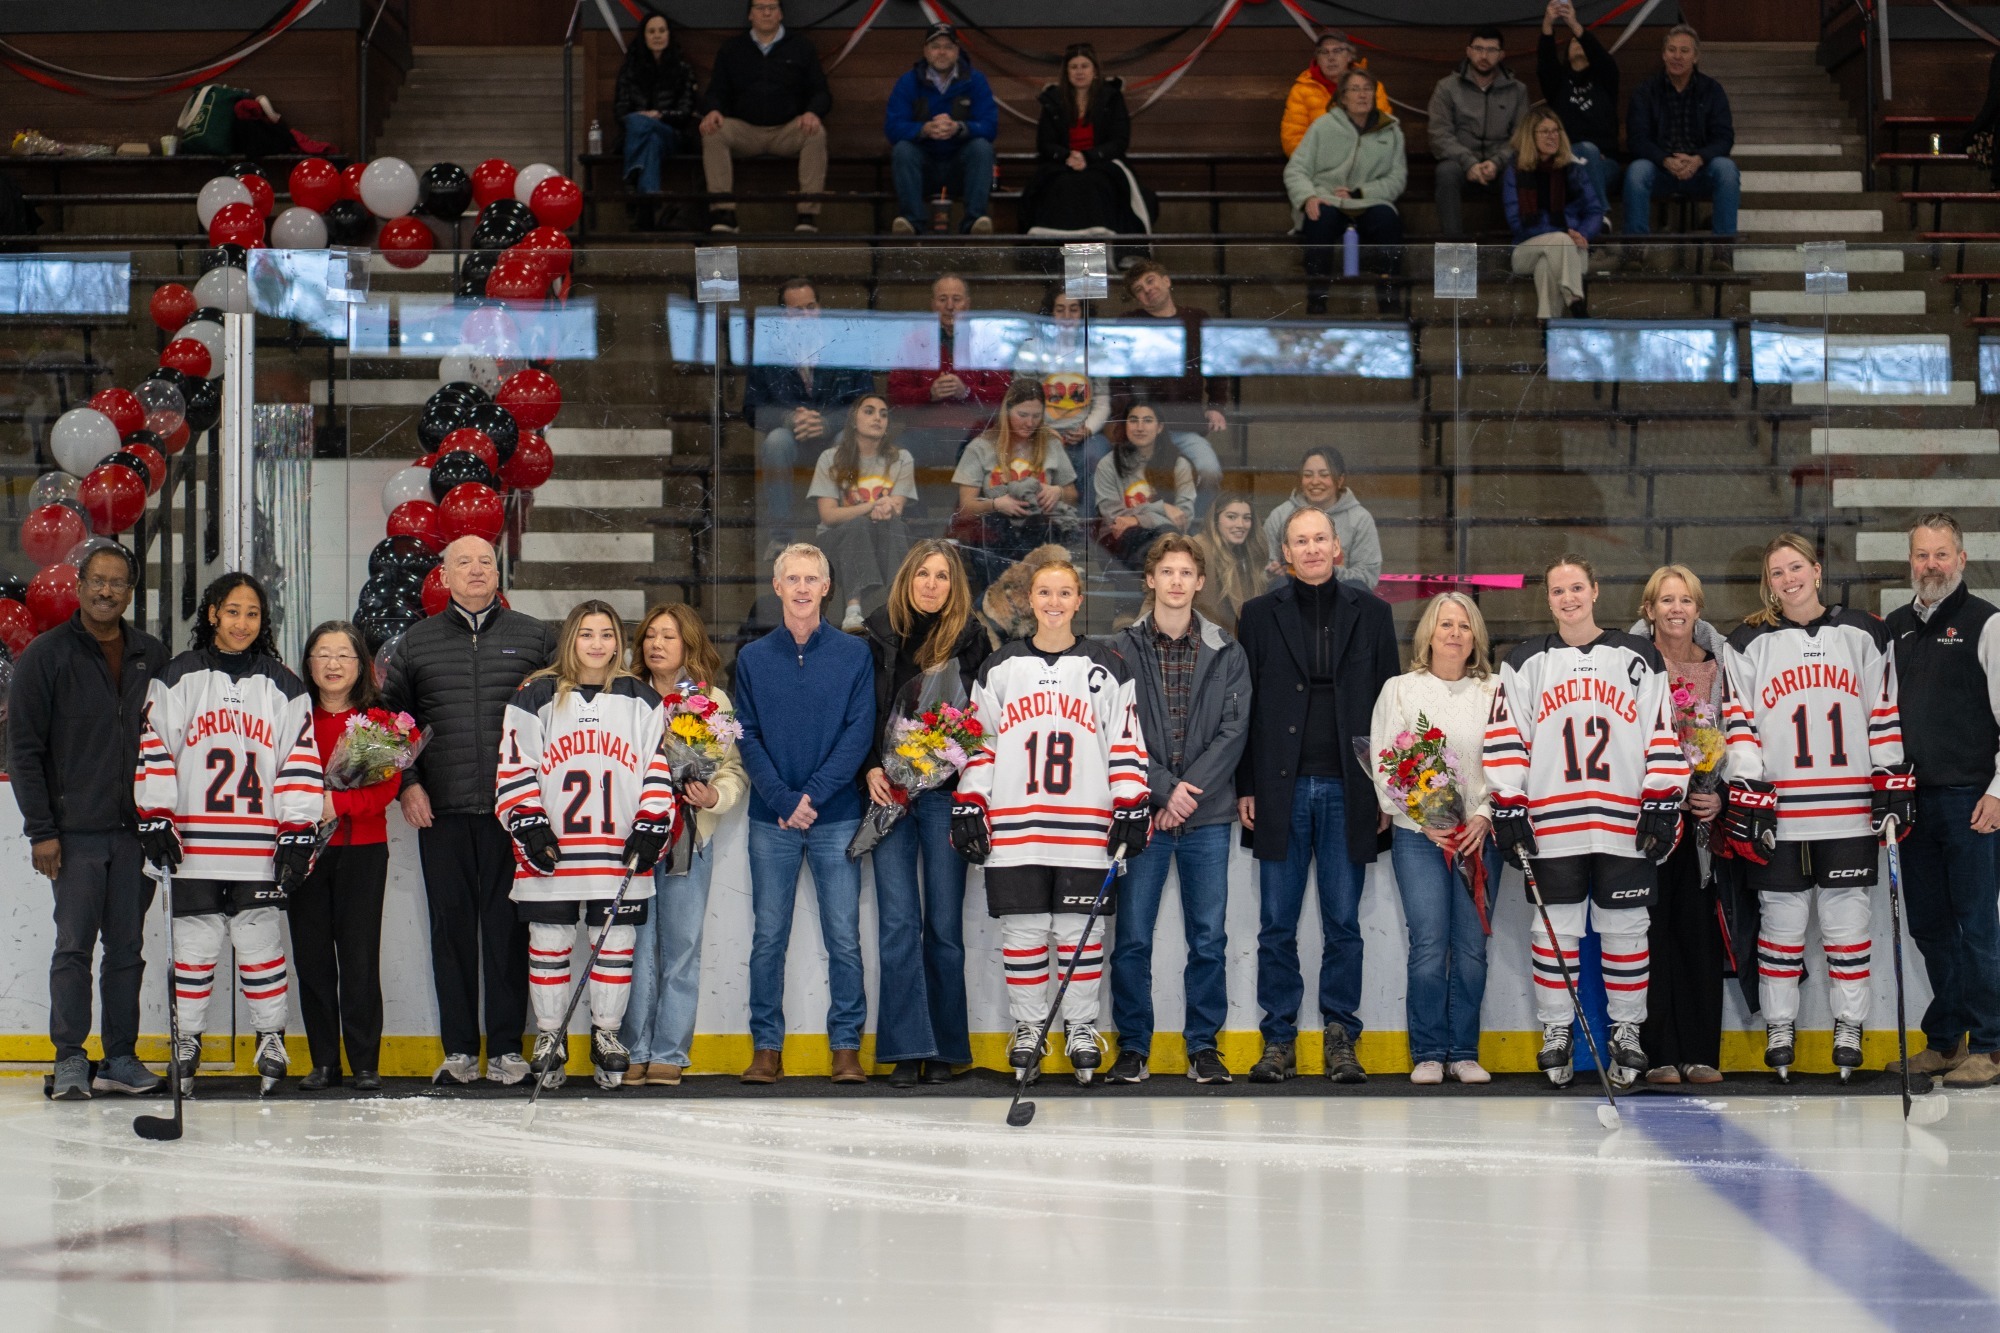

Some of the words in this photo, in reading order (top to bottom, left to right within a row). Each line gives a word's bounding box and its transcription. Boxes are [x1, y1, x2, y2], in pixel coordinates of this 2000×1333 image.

[1088, 666, 1108, 694] C
[1628, 656, 1647, 687] C
[1762, 663, 1859, 709] CARDINAL
[186, 708, 273, 749] CARDINAL
[295, 711, 314, 749] 2
[998, 690, 1097, 735] CARDINALS
[1121, 703, 1139, 742] 1
[1655, 695, 1678, 733] 1
[541, 729, 638, 776] CARDINALS
[1562, 715, 1611, 783] 12
[1791, 702, 1849, 769] 11
[205, 747, 264, 815] 24
[1024, 730, 1074, 796] 18
[562, 769, 615, 835] 21
[1729, 790, 1777, 807] CCM
[1885, 777, 1916, 789] CC
[138, 820, 168, 832] CM
[510, 816, 550, 833] CCM
[951, 806, 980, 815] CM
[1828, 868, 1869, 879] CCM
[1611, 887, 1650, 899] CCM
